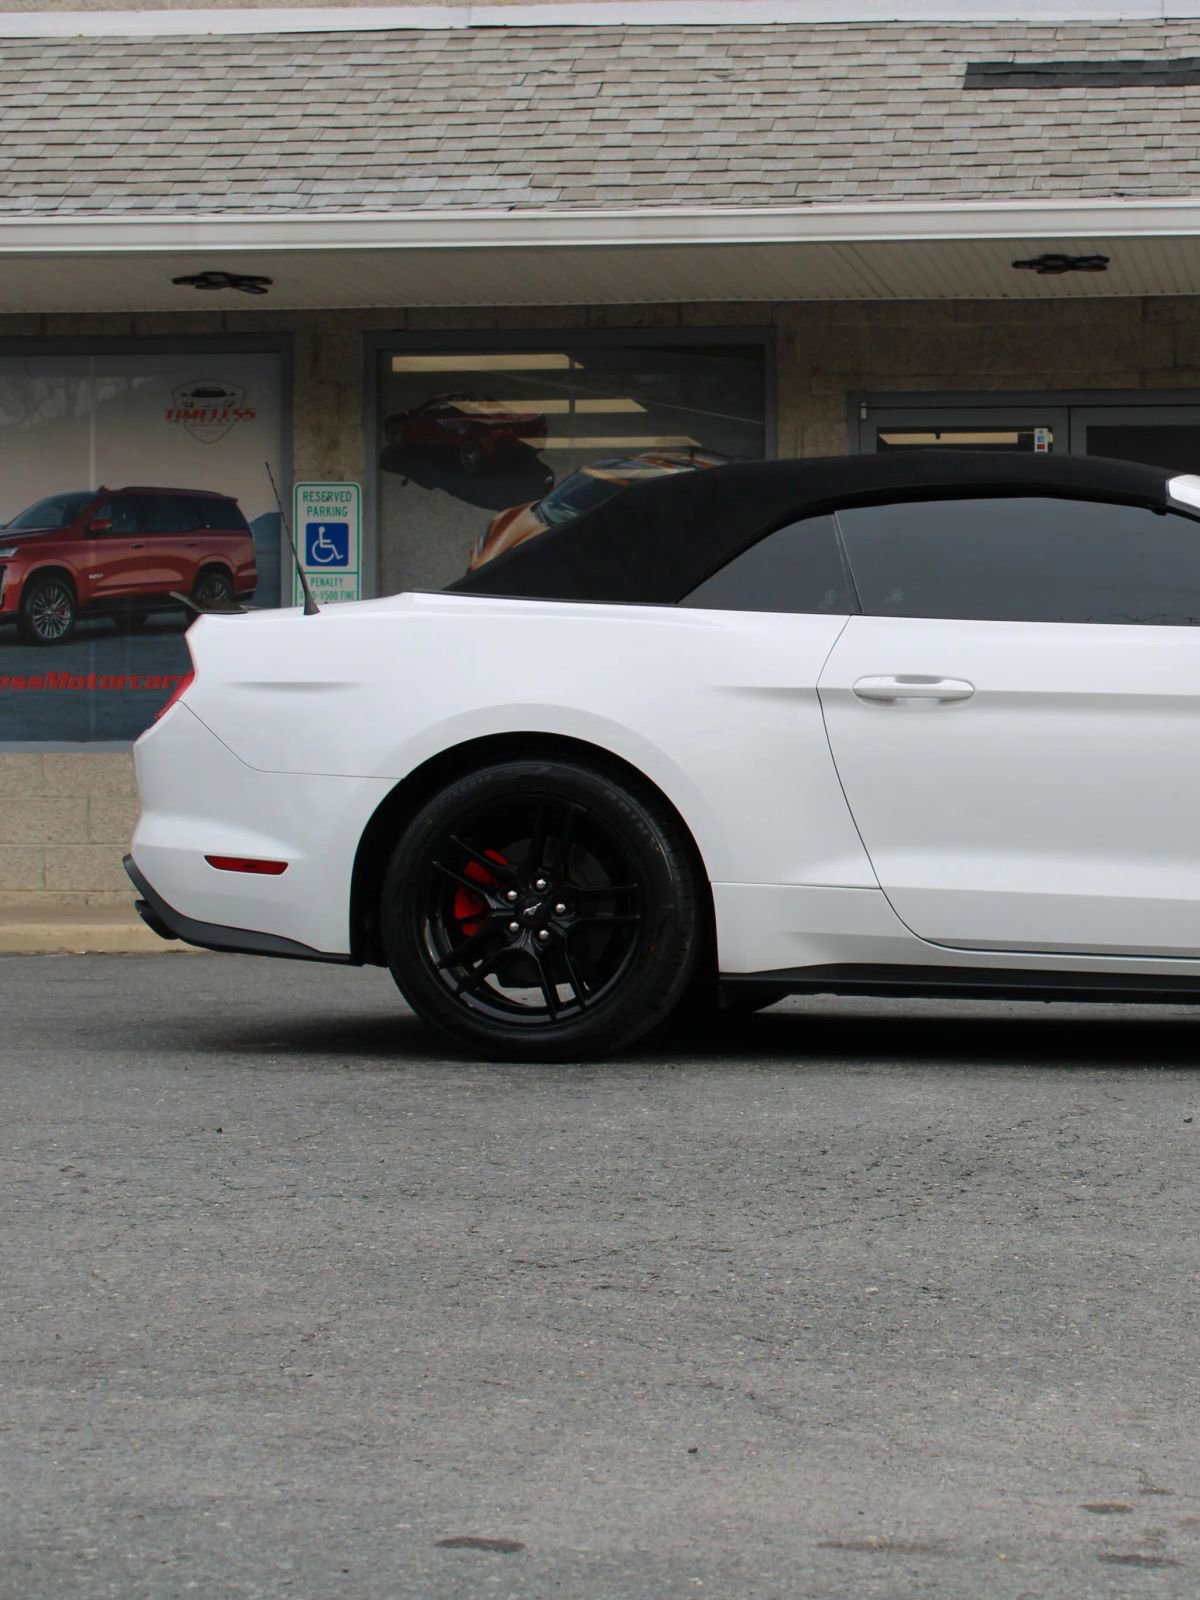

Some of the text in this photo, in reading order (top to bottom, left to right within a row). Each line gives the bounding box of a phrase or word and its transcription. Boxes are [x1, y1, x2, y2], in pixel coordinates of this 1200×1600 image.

[302, 491, 352, 502] RESERVED
[307, 505, 348, 517] PARKING
[310, 576, 344, 587] PENALTY
